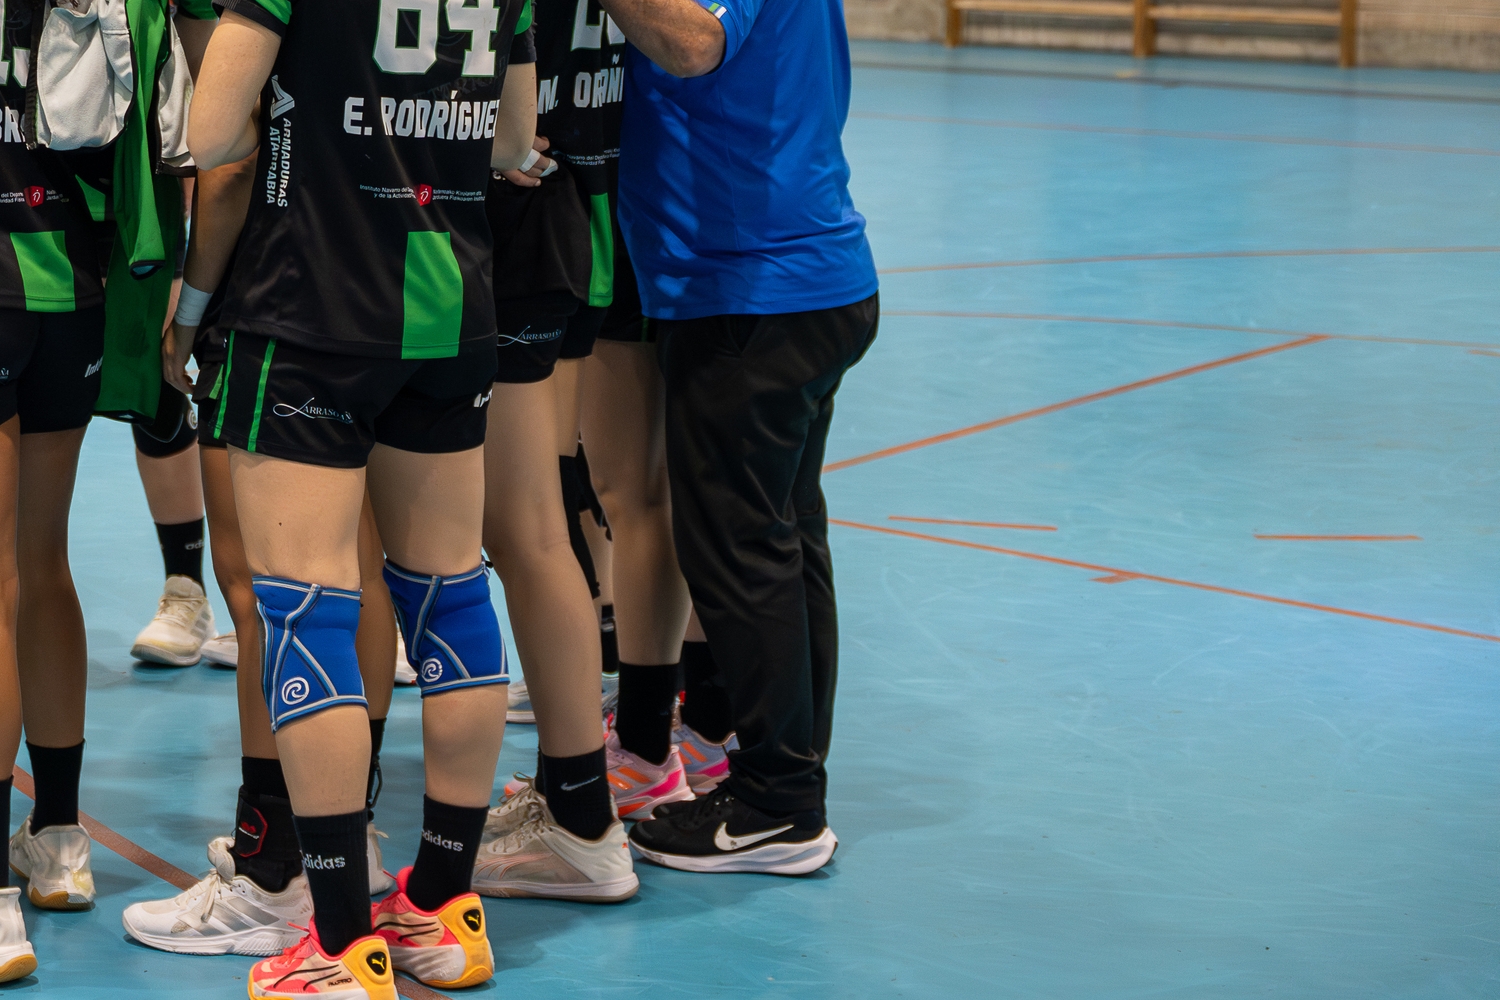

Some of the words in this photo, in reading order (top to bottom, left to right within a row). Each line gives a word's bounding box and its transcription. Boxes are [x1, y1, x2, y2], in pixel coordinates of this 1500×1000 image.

[343, 96, 373, 136] E.
[266, 126, 281, 204] ATARRABIA
[277, 117, 292, 208] ARMADURAS
